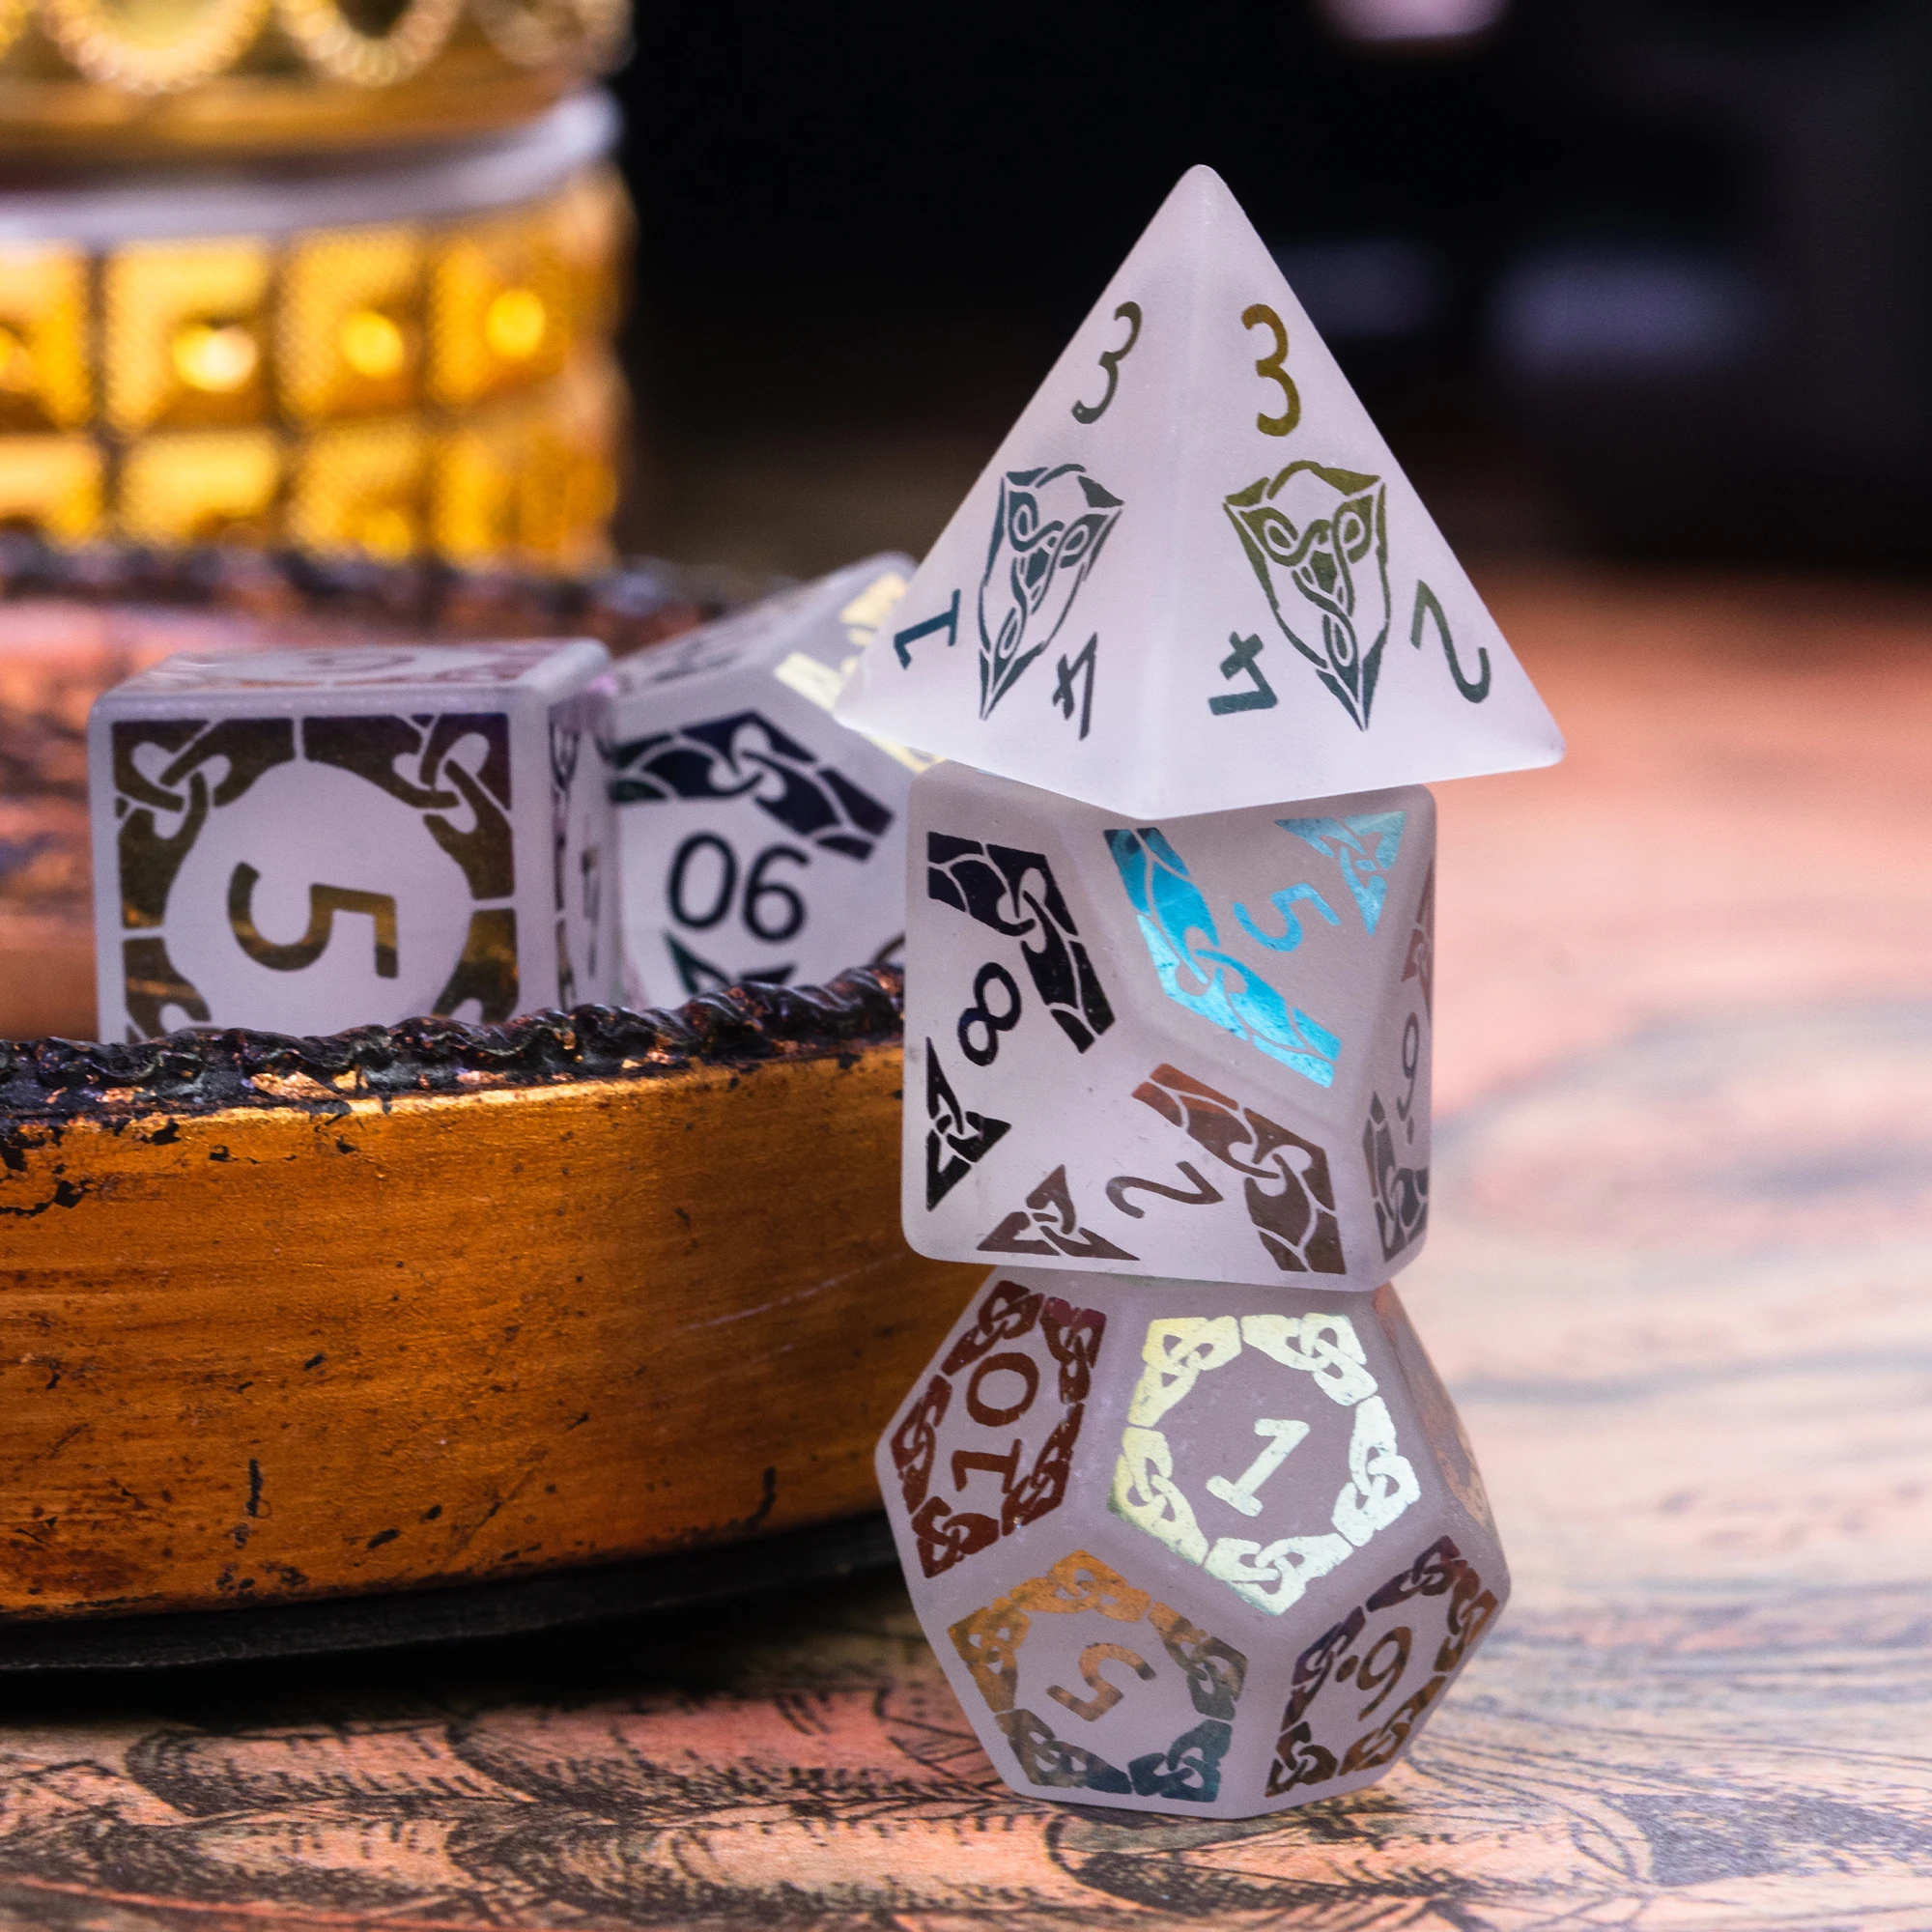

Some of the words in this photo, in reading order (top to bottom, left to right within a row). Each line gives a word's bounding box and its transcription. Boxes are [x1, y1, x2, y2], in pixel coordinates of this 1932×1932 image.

[1071, 300, 1142, 425] 3
[1241, 303, 1301, 437] 3
[894, 588, 961, 668] 1
[1208, 631, 1279, 716] 4
[1409, 580, 1492, 703] 2
[1053, 632, 1098, 741] 4
[228, 861, 399, 979] 5
[957, 961, 1022, 1066] 8
[1106, 1161, 1224, 1219] 2
[951, 1351, 1040, 1495] 10
[1206, 1418, 1311, 1518] 1
[1046, 1642, 1156, 1722] 5
